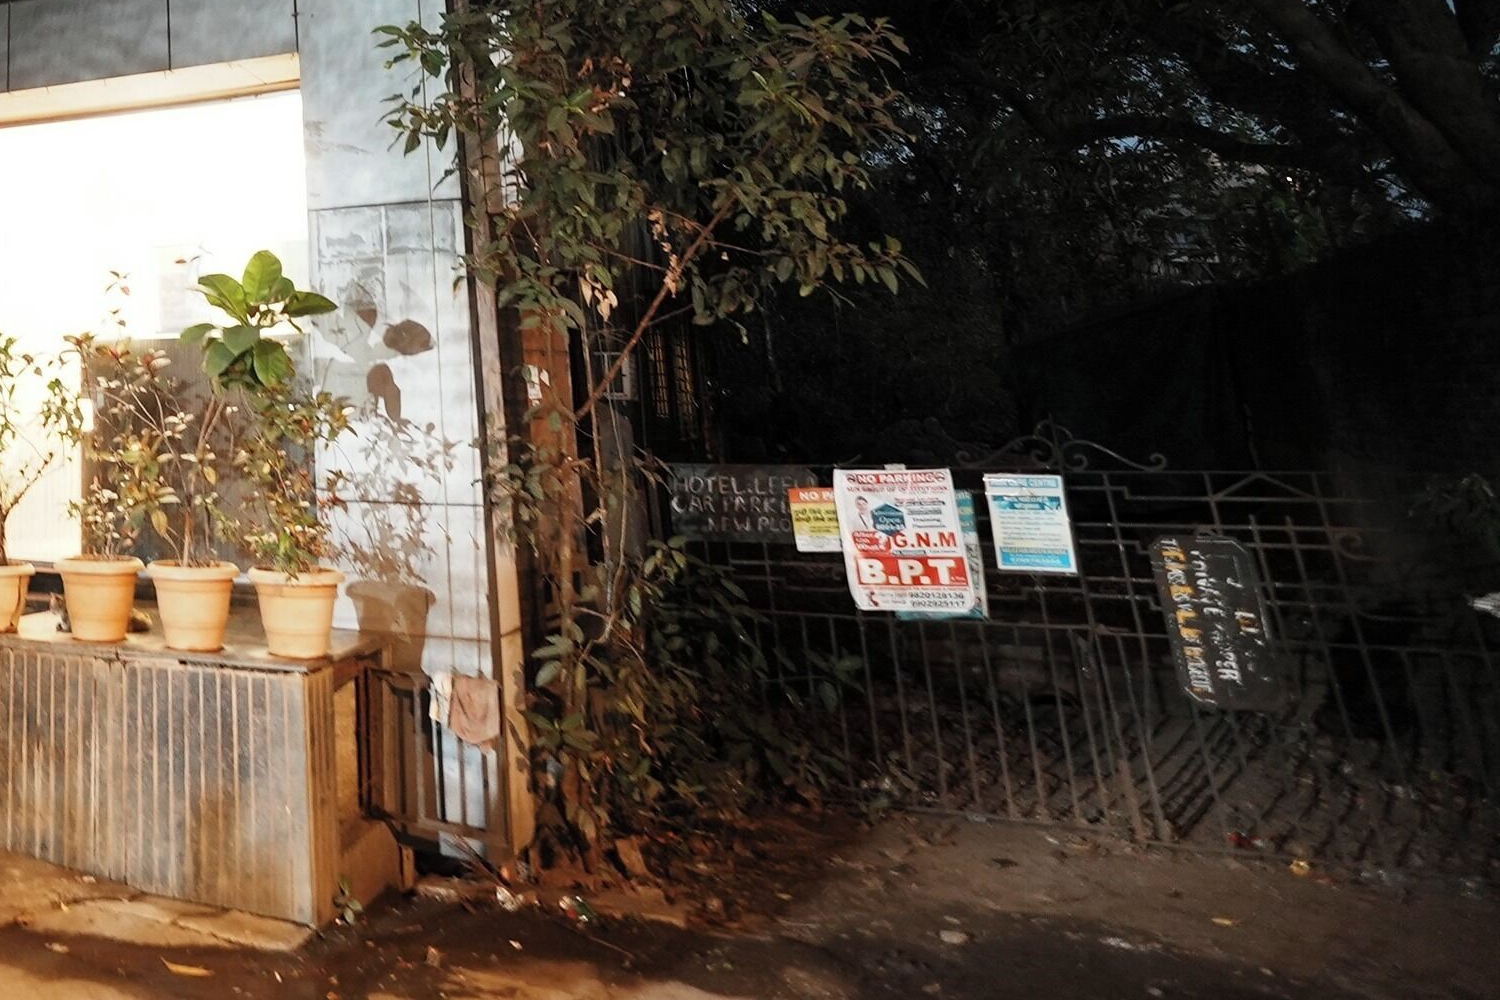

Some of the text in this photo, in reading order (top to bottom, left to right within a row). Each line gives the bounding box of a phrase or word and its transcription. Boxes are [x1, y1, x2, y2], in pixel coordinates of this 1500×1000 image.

[857, 472, 937, 484] NO PARKING
[799, 491, 820, 502] NO
[671, 496, 716, 514] CAR
[894, 531, 958, 548] G.N.M
